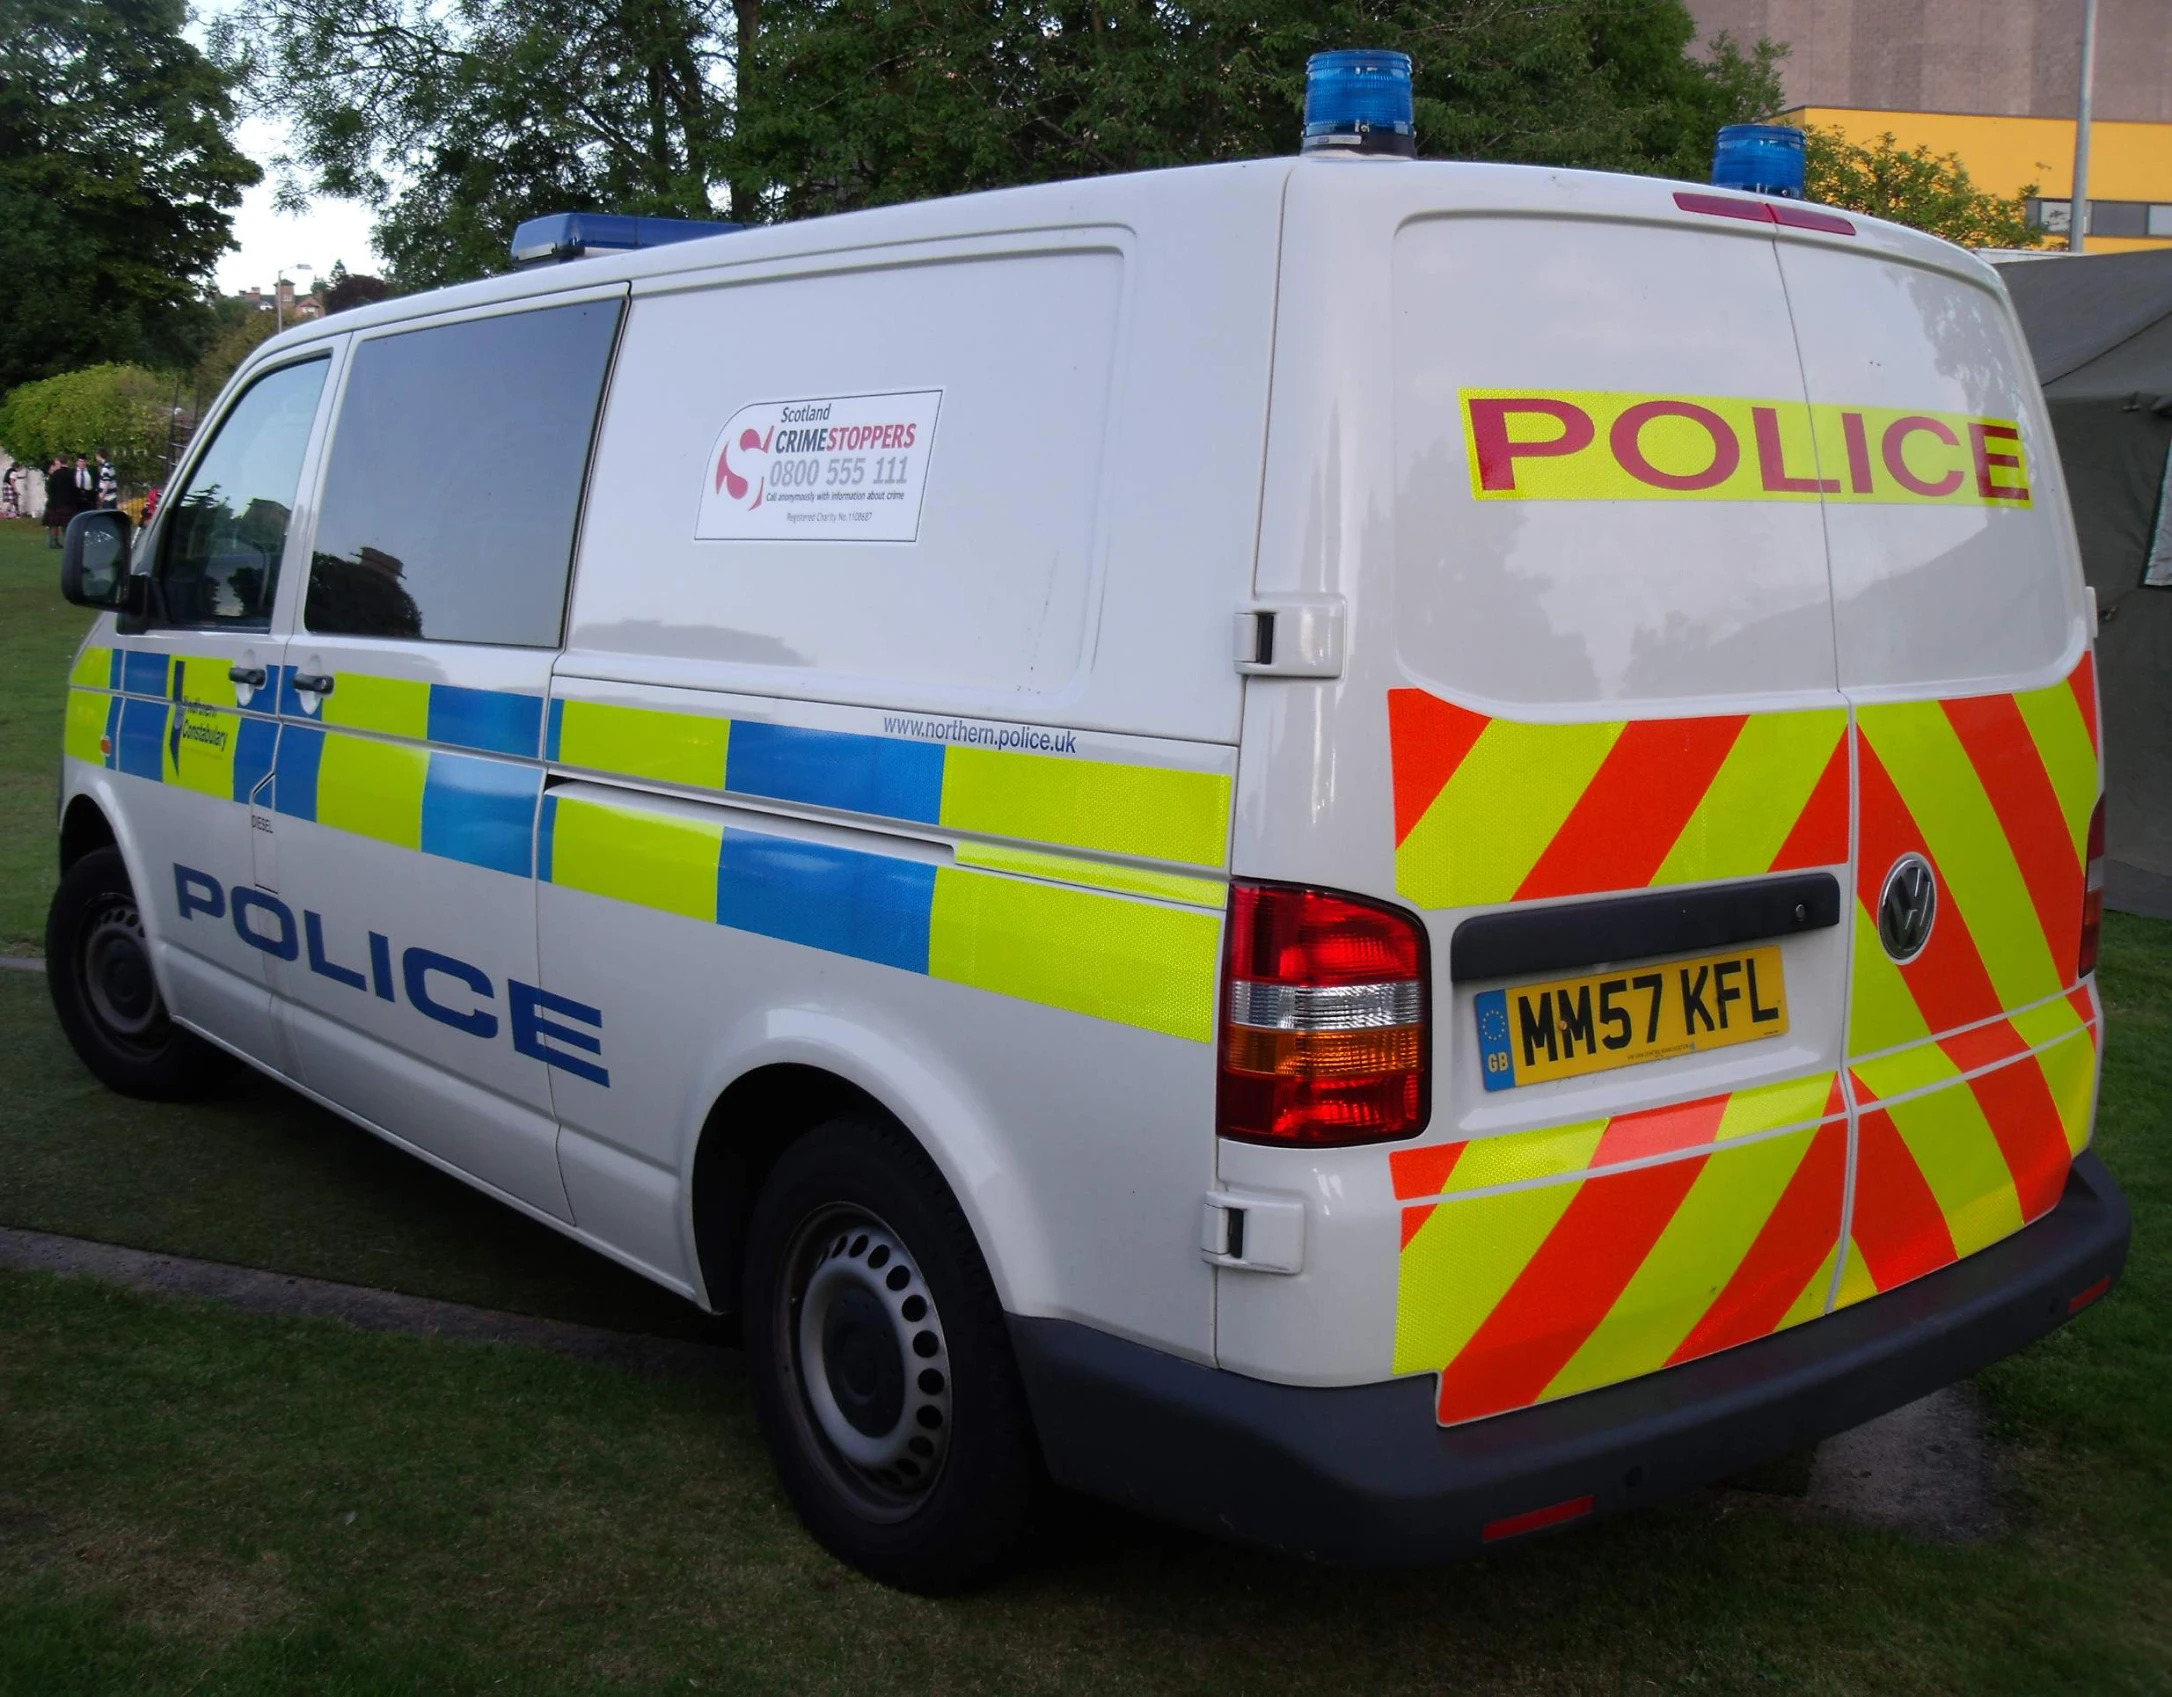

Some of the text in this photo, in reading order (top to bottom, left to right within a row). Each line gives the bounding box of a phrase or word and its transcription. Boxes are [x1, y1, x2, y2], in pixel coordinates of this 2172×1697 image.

[780, 403, 832, 423] Scotland
[1468, 397, 2031, 501] POLICE
[769, 456, 909, 487] 0800 555 111
[766, 490, 905, 503] Call anonymously with information about crime
[183, 719, 229, 752] Constabulary
[884, 717, 1077, 753] www.northern.police.uk
[251, 814, 274, 834] DIESEL
[173, 862, 611, 1088] POLICE
[1517, 957, 1780, 1066] MM57 KFL
[1487, 1051, 1509, 1073] GB
